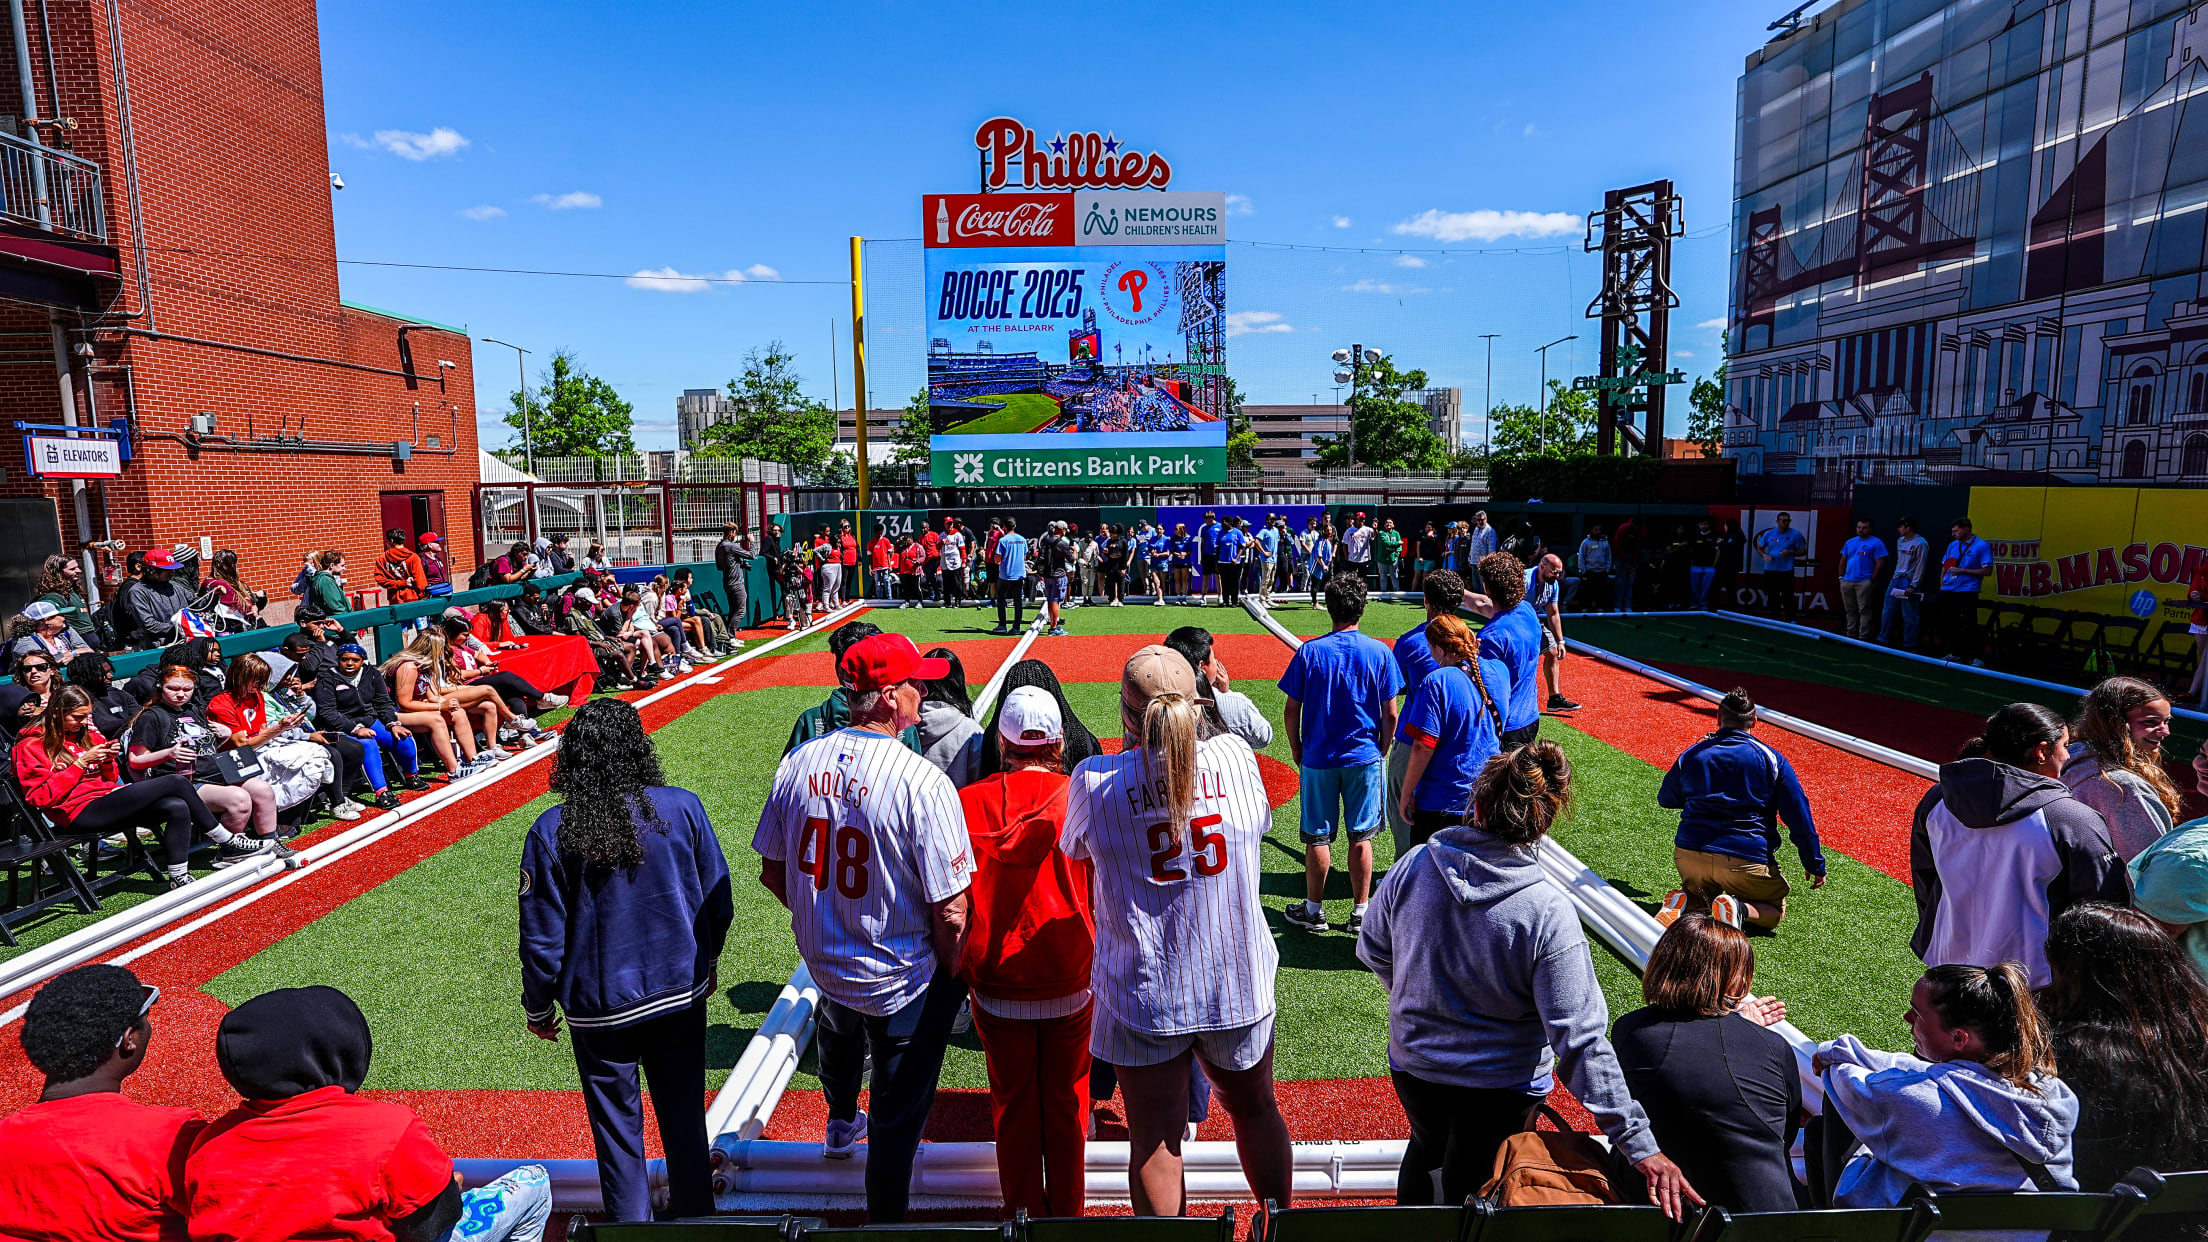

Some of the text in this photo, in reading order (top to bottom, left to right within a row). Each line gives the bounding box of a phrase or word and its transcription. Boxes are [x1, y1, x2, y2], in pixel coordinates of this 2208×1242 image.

[975, 116, 1171, 190] Phillies
[956, 203, 1060, 237] Coca-Cola
[1125, 208, 1217, 221] NEMOURS
[1125, 225, 1217, 236] CHILDREN'S HEALTH
[938, 269, 1085, 320] BOCCE 2025
[967, 324, 1055, 333] AT THE BALLPARK
[1572, 367, 1687, 390] Citizens Bank
[1608, 388, 1648, 406] Park
[63, 449, 109, 463] ELEVATORS
[993, 457, 1082, 478] Citizens
[1087, 455, 1143, 476] Bank
[875, 515, 914, 537] 334
[1990, 543, 2040, 557] HO BUT
[809, 771, 868, 809] NOLES
[1126, 771, 1226, 815] FARLL
[798, 815, 870, 899] 48
[1147, 813, 1228, 882] 25
